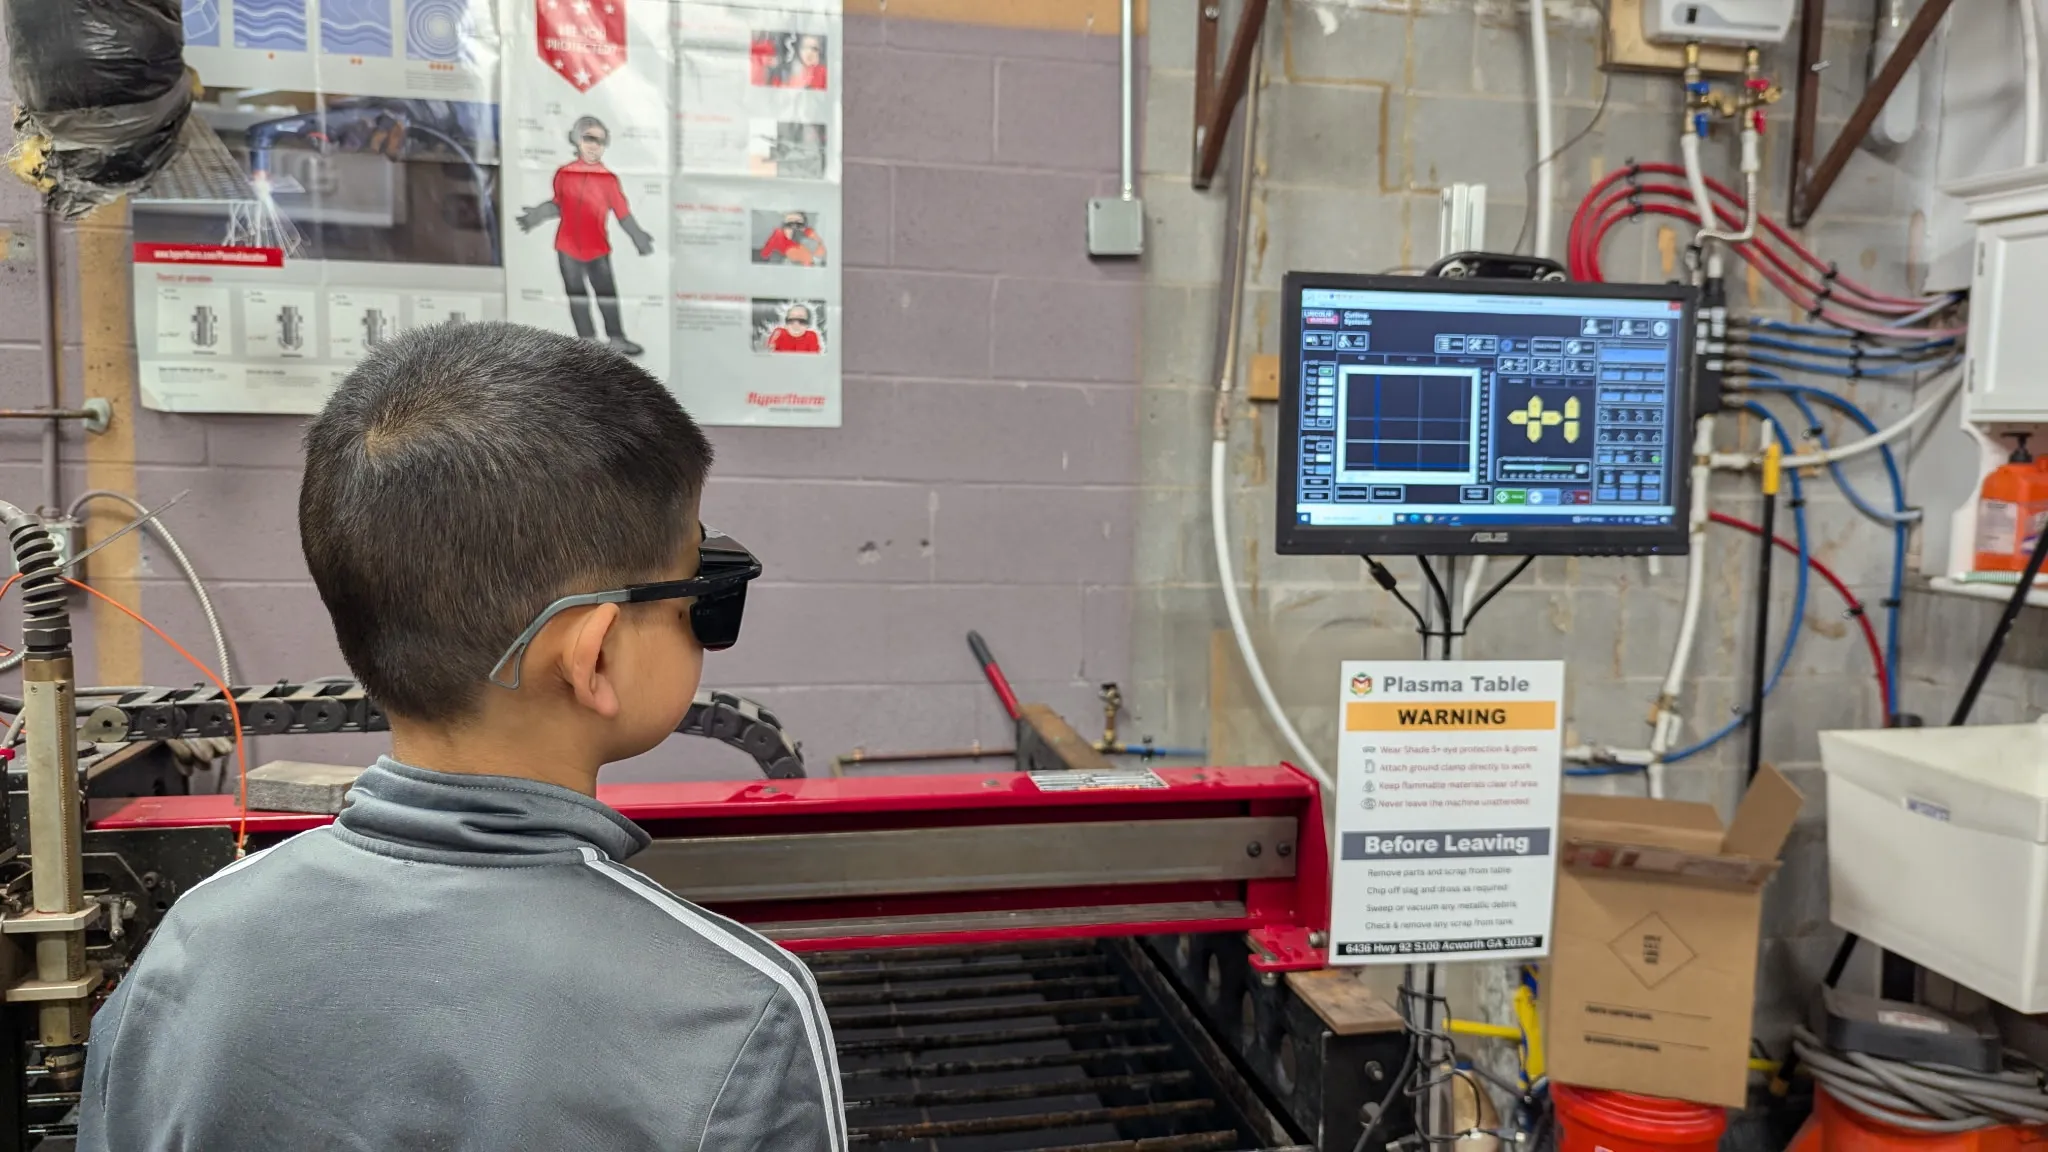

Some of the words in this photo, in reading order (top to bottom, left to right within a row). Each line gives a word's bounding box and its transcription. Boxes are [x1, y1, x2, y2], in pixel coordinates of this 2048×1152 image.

[1470, 531, 1508, 543] ASUS
[1383, 676, 1463, 693] Plasma
[1470, 675, 1529, 692] Table
[1397, 708, 1506, 725] WARNING
[1380, 745, 1400, 754] Wear
[1404, 745, 1429, 754] Shade
[1443, 747, 1457, 756] eye
[1459, 745, 1502, 755] protection
[1511, 745, 1538, 755] gloves
[1379, 763, 1407, 772] Attach
[1409, 763, 1439, 774] ground
[1441, 763, 1466, 773] clamp
[1468, 762, 1499, 773] directly
[1500, 762, 1510, 770] to
[1511, 762, 1531, 771] work
[1379, 781, 1400, 792] Keep
[1402, 780, 1446, 790] flammable
[1447, 780, 1485, 789] materials
[1487, 780, 1507, 788] clear
[1509, 779, 1519, 788] of
[1378, 799, 1403, 808] Never
[1405, 799, 1427, 808] leave
[1429, 798, 1443, 807] the
[1444, 798, 1480, 807] machine
[1481, 796, 1530, 806] unattended
[1364, 834, 1439, 854] Before
[1444, 833, 1530, 855] Leaving
[1367, 869, 1401, 877] Remove
[1403, 868, 1425, 878] parts
[1427, 867, 1442, 876] and
[1444, 868, 1467, 877] scrap
[1468, 866, 1488, 875] from
[1490, 866, 1512, 875] table
[1366, 886, 1387, 897] Chip
[1387, 885, 1401, 895] off
[1402, 886, 1418, 896] slag
[1420, 885, 1436, 894] and
[1437, 884, 1460, 893] dross
[1473, 883, 1508, 894] required
[1366, 904, 1394, 914] Sweep
[1406, 904, 1439, 912] vacuum
[1441, 904, 1456, 913] any
[1457, 901, 1490, 911] metallic
[1491, 900, 1518, 909] debris
[1365, 921, 1391, 931] Check
[1400, 921, 1432, 930] remove
[1433, 920, 1448, 930] any
[1450, 920, 1472, 930] scrap
[1474, 918, 1493, 927] from
[1345, 944, 1372, 954] 6436
[1373, 943, 1397, 954] Hwy
[1399, 942, 1412, 952] 92
[1414, 941, 1440, 952] S100
[1442, 940, 1484, 951] Acworth
[1486, 939, 1503, 949] GA
[1504, 937, 1536, 948] 30102
